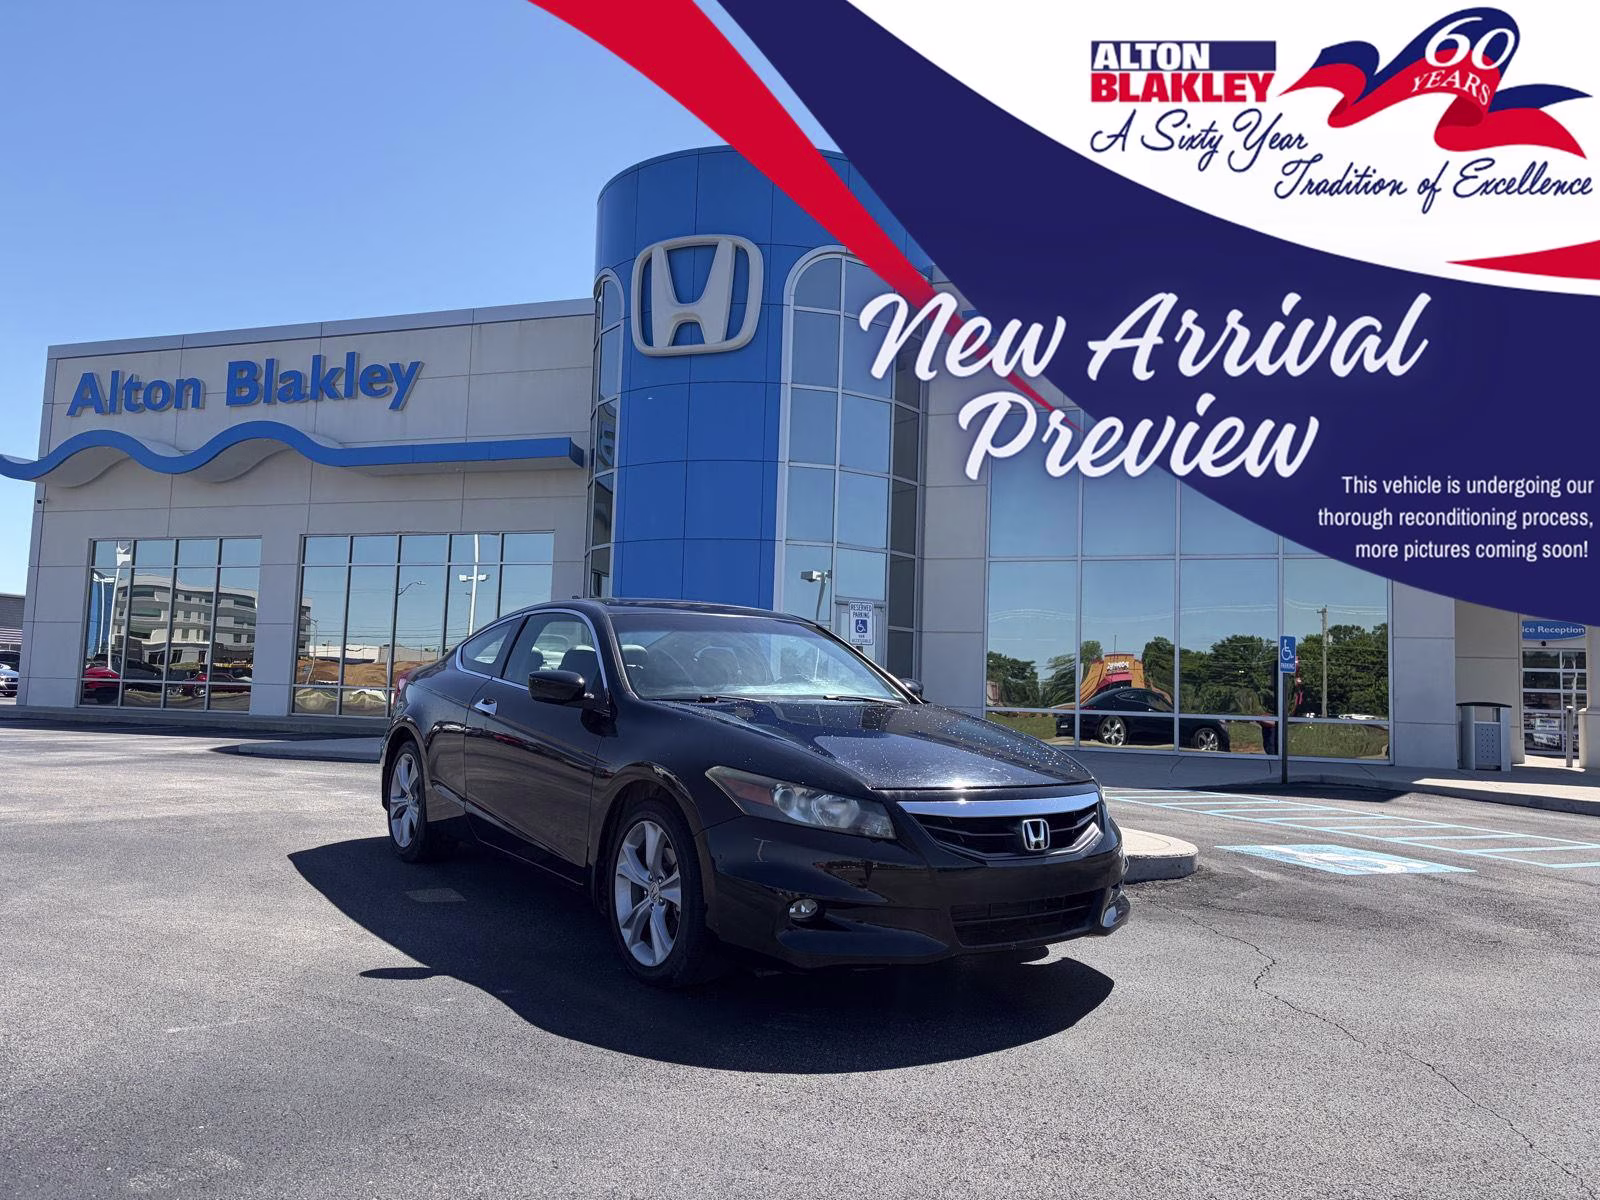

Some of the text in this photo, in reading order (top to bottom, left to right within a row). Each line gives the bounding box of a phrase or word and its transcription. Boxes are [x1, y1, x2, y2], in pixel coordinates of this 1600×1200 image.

[66, 351, 424, 417] Alton Blakley
[851, 603, 872, 611] RESERVED
[1537, 625, 1585, 635] Reception
